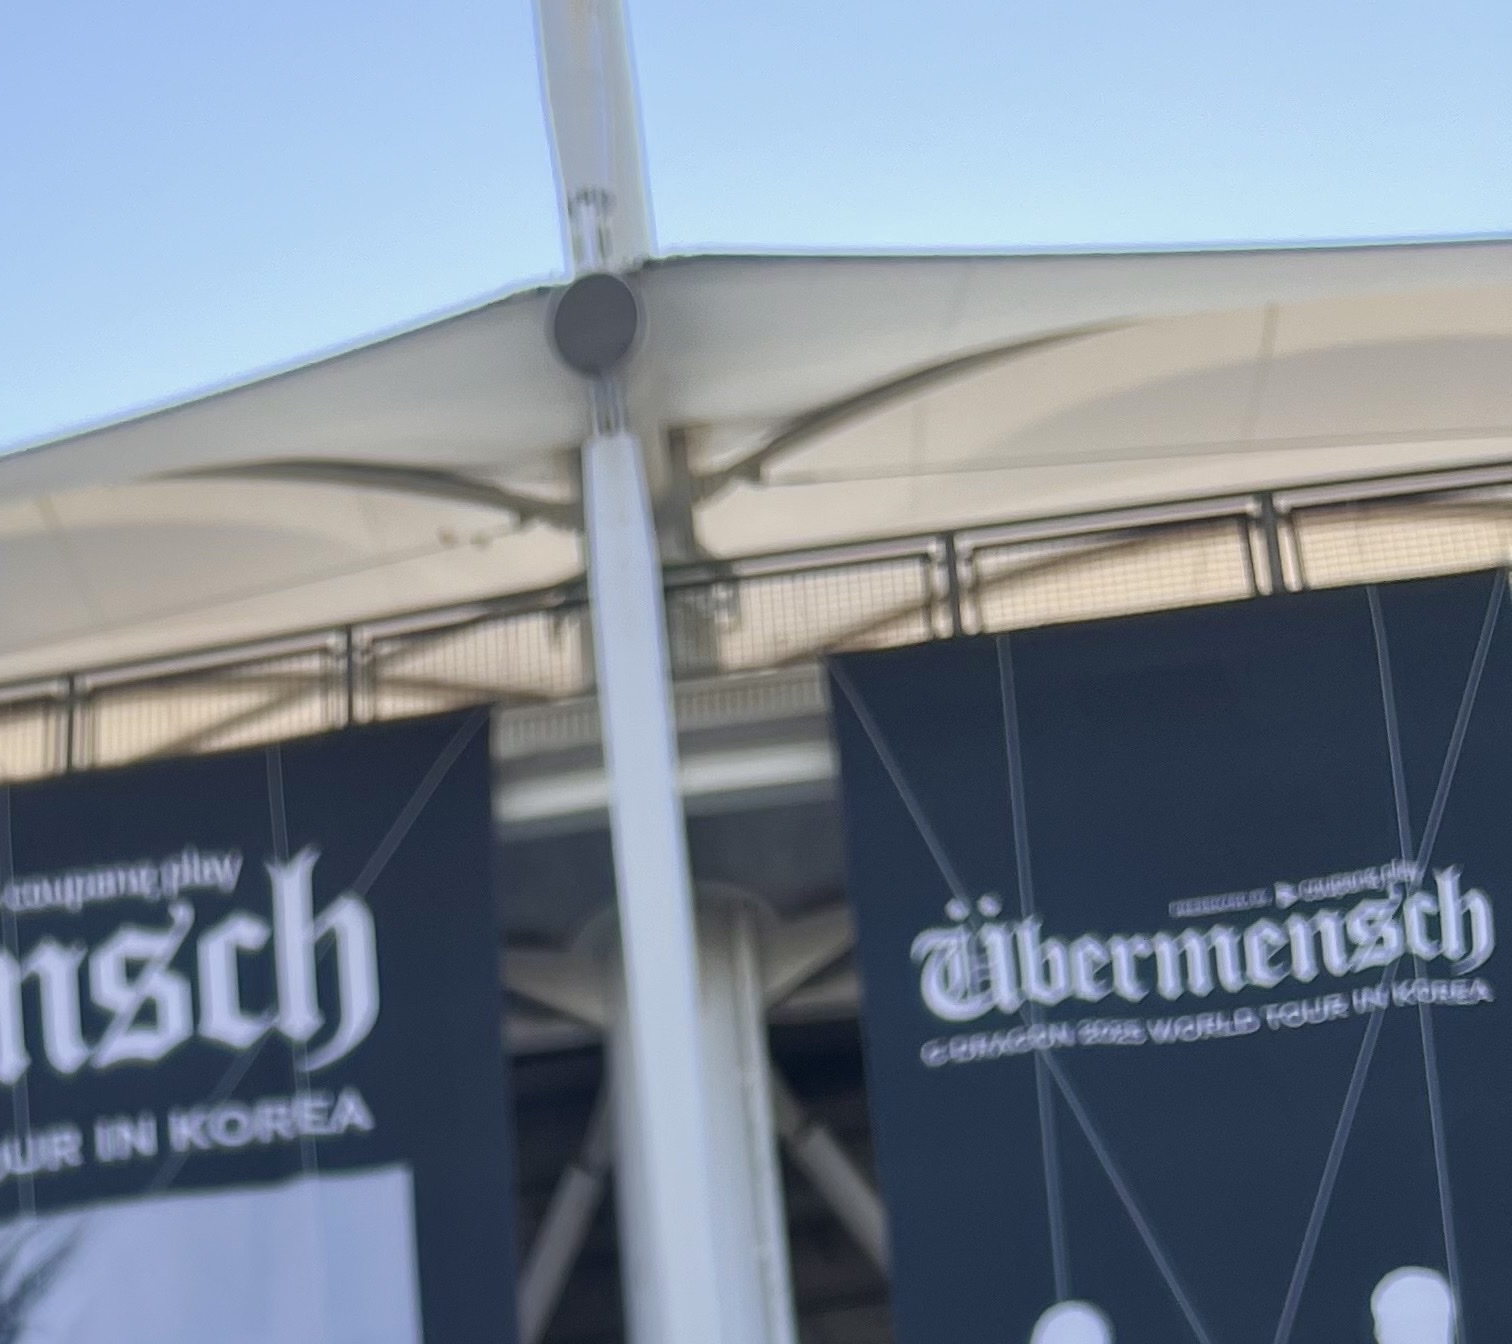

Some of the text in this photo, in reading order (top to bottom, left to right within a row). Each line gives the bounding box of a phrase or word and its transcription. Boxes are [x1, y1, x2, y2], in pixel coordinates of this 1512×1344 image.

[910, 864, 1496, 1022] Übermensch
[1146, 1006, 1261, 1042] WORLD
[1262, 993, 1349, 1030] TOUR
[1352, 984, 1388, 1014] IN
[1391, 977, 1494, 1007] KOREA
[94, 1110, 157, 1162] IN
[168, 1086, 375, 1150] KOREA
